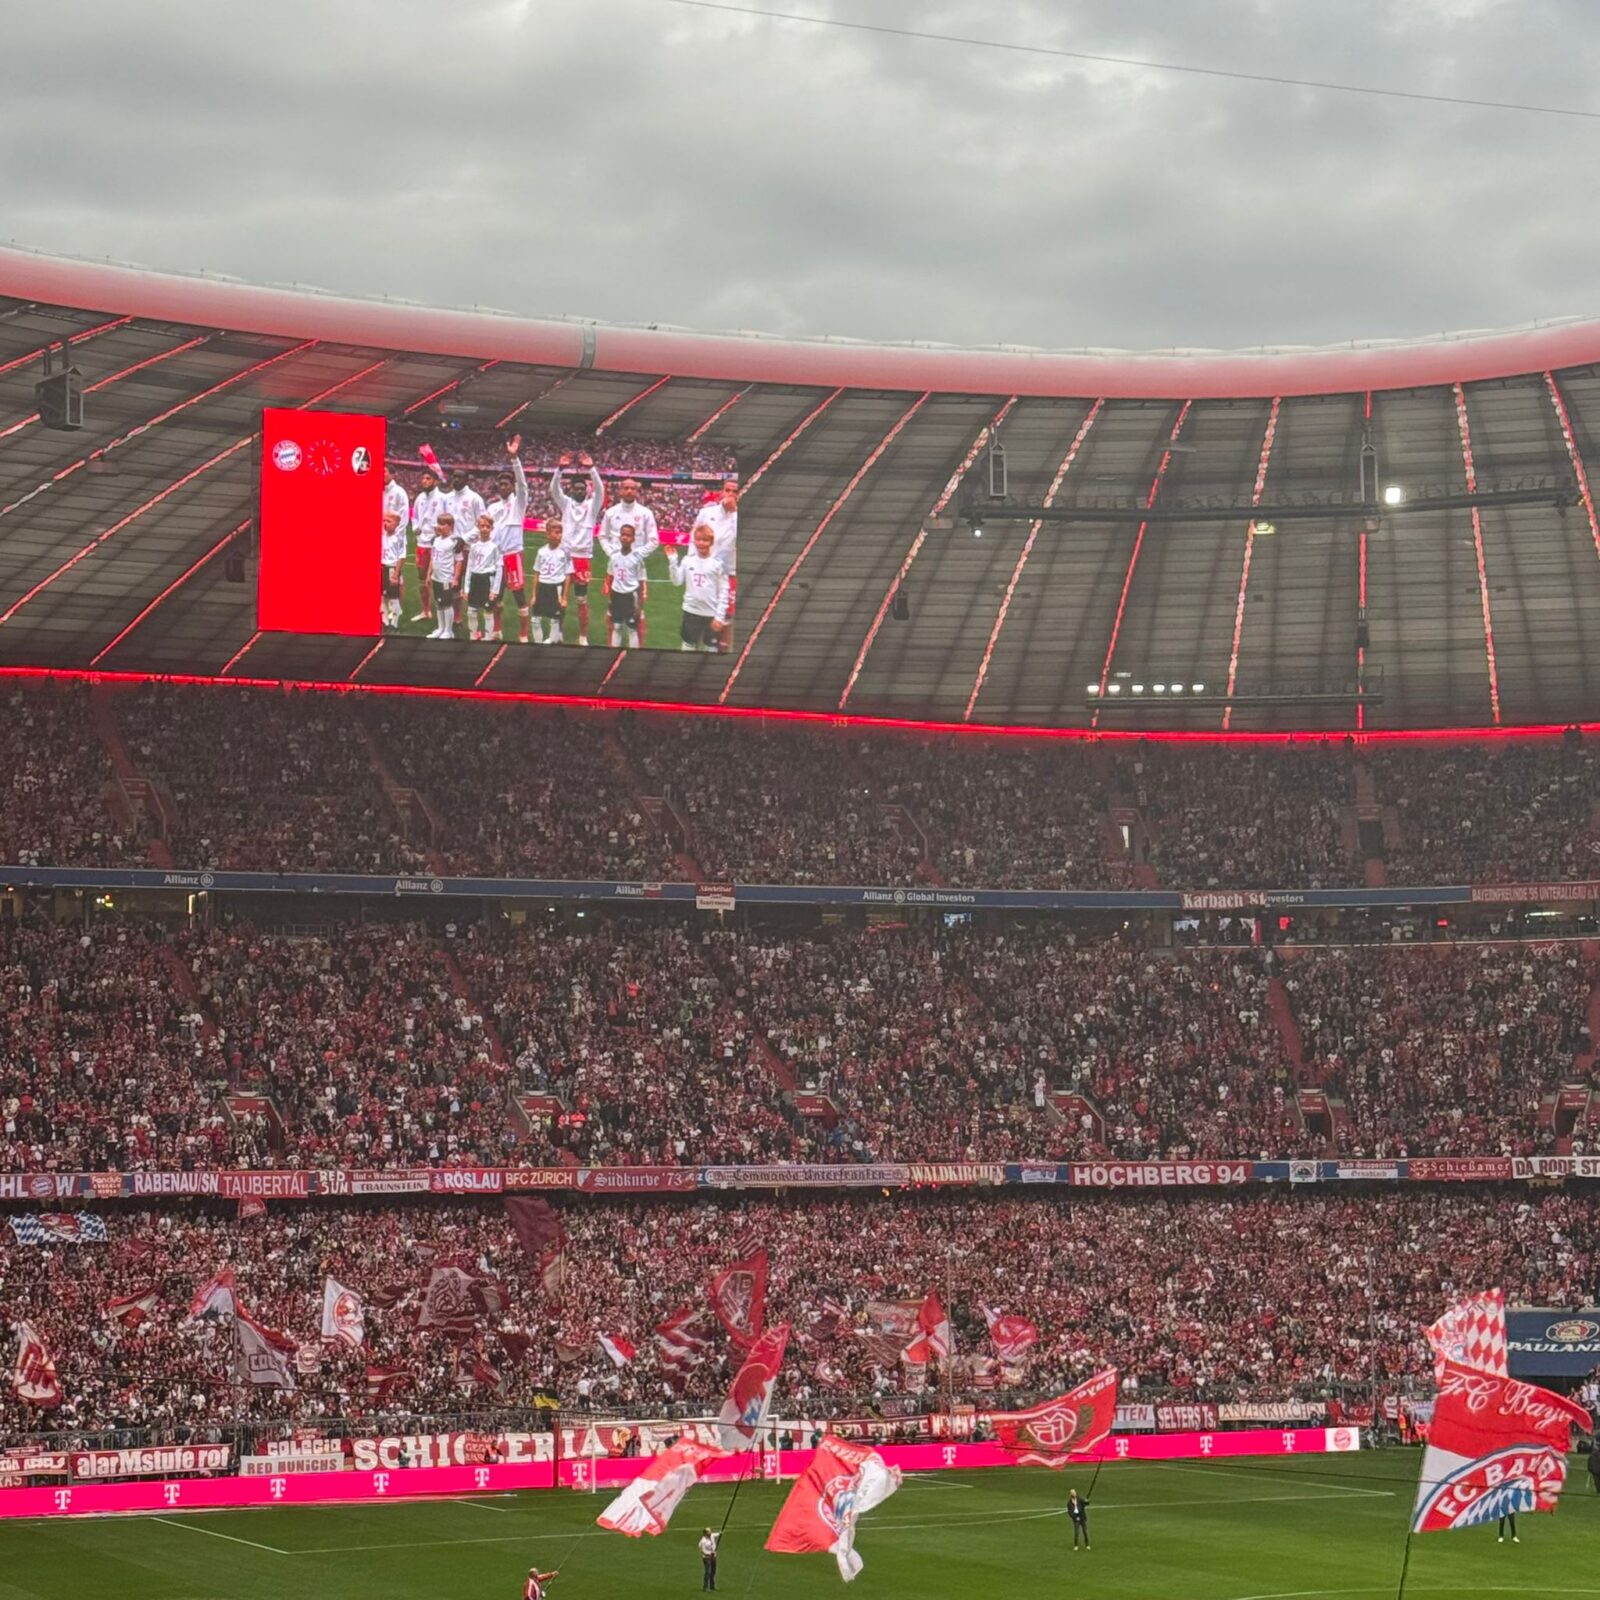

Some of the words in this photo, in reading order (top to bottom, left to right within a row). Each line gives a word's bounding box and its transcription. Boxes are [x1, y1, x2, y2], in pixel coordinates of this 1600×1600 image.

[164, 874, 199, 886] Allianz
[395, 879, 427, 891] Allianz
[615, 884, 644, 895] Allian
[863, 891, 892, 901] Allianz
[906, 891, 934, 902] Global
[936, 892, 975, 903] Investors
[1183, 893, 1243, 909] Karbach
[319, 1170, 346, 1182] RED
[505, 1171, 529, 1185] BFC
[530, 1168, 573, 1185] ZÜRICH
[1515, 1160, 1535, 1176] DA
[134, 1174, 219, 1194] RABENAU/SN
[361, 1181, 424, 1192] TRAUNSTEIN
[444, 1168, 501, 1189] RÖSLAU
[594, 1168, 660, 1188] Südkurve
[662, 1170, 682, 1186] '73
[320, 1181, 348, 1195] SUN
[1157, 1405, 1201, 1430] SELTERS
[1115, 1438, 1129, 1457] T
[1200, 1435, 1213, 1454] T
[1282, 1432, 1295, 1451] T
[77, 1449, 195, 1476] alarMstufe
[199, 1446, 230, 1467] rot
[764, 1454, 776, 1473] T
[942, 1446, 957, 1464] T
[247, 1462, 272, 1475] RED
[475, 1467, 490, 1487] T
[573, 1463, 587, 1482] T
[270, 1478, 286, 1498] T
[373, 1472, 389, 1493] T
[55, 1489, 71, 1510] T
[164, 1483, 180, 1504] T
